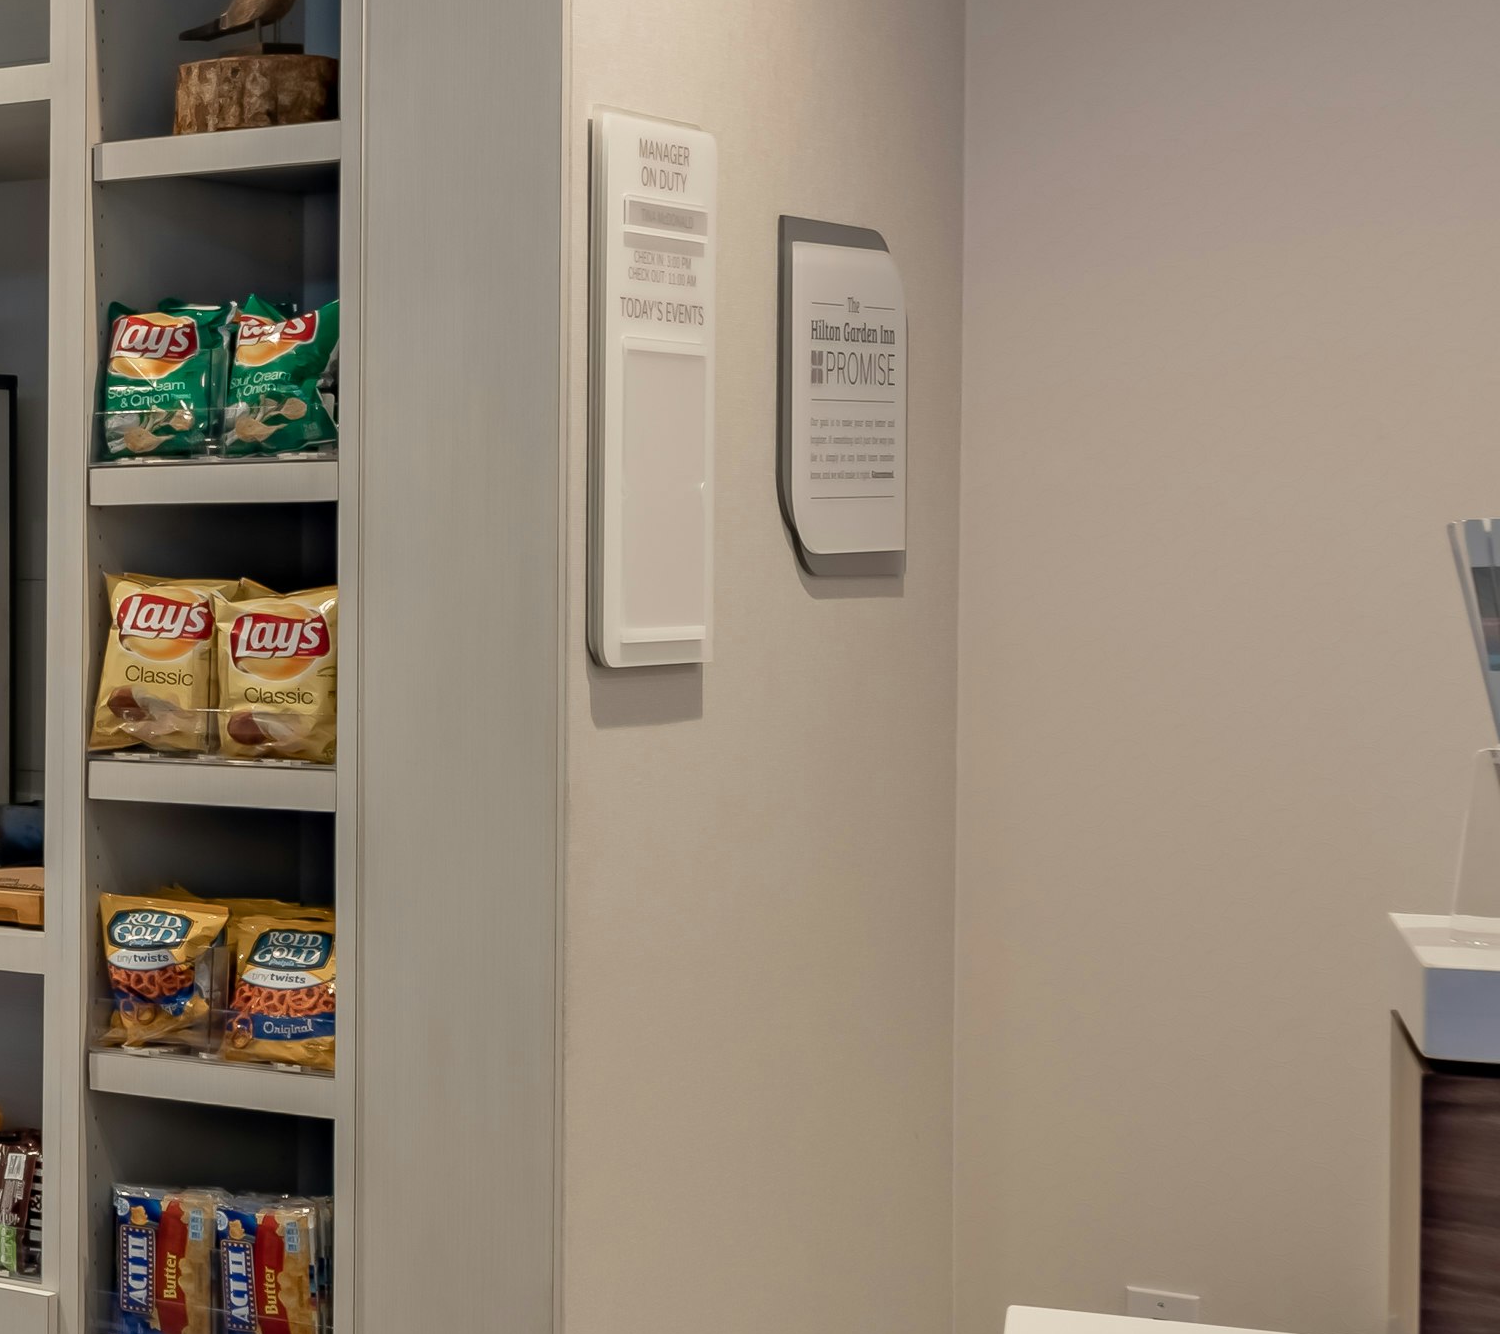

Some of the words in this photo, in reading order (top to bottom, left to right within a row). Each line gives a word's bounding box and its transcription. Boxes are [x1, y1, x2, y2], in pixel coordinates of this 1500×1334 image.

[639, 138, 690, 168] MANAGER
[642, 166, 657, 187] ON
[659, 169, 688, 193] DUTY
[620, 296, 663, 323] TODAY'S
[666, 302, 705, 326] EVENTS
[847, 297, 860, 314] The
[110, 318, 191, 359] Lay's
[811, 320, 841, 342] Hilton
[844, 322, 877, 344] Garden
[880, 325, 895, 345] Inn
[253, 370, 292, 384] Cream
[826, 351, 896, 386] PROMISE
[120, 398, 128, 408] &
[121, 596, 208, 639] Lay's
[236, 616, 323, 659] Lay's
[125, 665, 194, 686] Classic
[244, 687, 313, 705] Classic
[124, 911, 182, 928] ROLD
[113, 923, 178, 944] GOLD
[268, 931, 323, 948] ROLD
[116, 953, 133, 963] tiny
[133, 952, 169, 962] twists
[253, 947, 321, 965] GOLD
[251, 971, 269, 981] tiny
[270, 973, 306, 984] twists
[263, 1019, 314, 1038] Original
[164, 1252, 177, 1299] Butter
[264, 1266, 279, 1315] Butter
